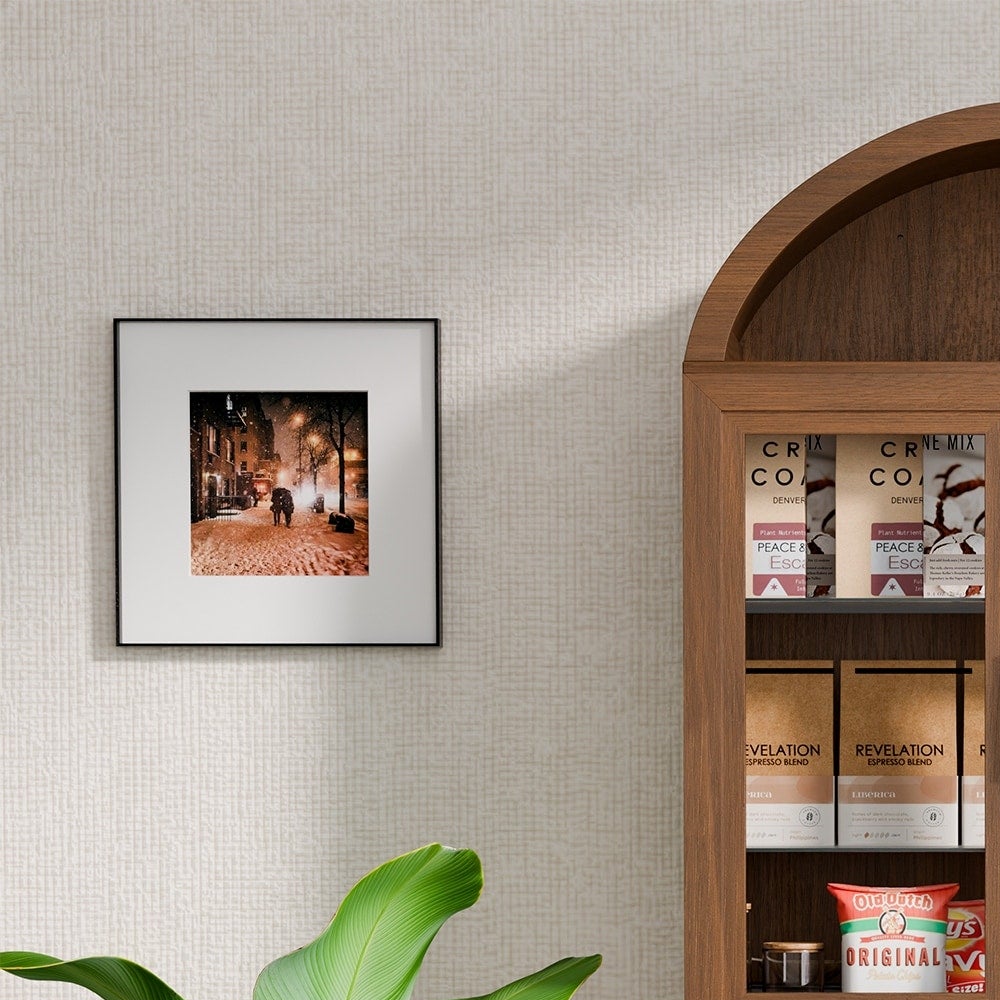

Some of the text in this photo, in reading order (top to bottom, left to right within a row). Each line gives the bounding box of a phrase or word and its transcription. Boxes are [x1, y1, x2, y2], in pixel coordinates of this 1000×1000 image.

[805, 434, 822, 450] IX
[947, 434, 975, 450] MIX
[869, 468, 923, 486] CO
[891, 496, 923, 504] DENVER
[757, 542, 796, 553] PEACE
[875, 542, 923, 553] PEACE &
[855, 744, 944, 757] REVELATION
[783, 758, 809, 766] BLEND
[868, 758, 933, 766] ESPRESSO BLEND
[853, 894, 883, 911] Old
[846, 946, 941, 967] ORIGINAL
